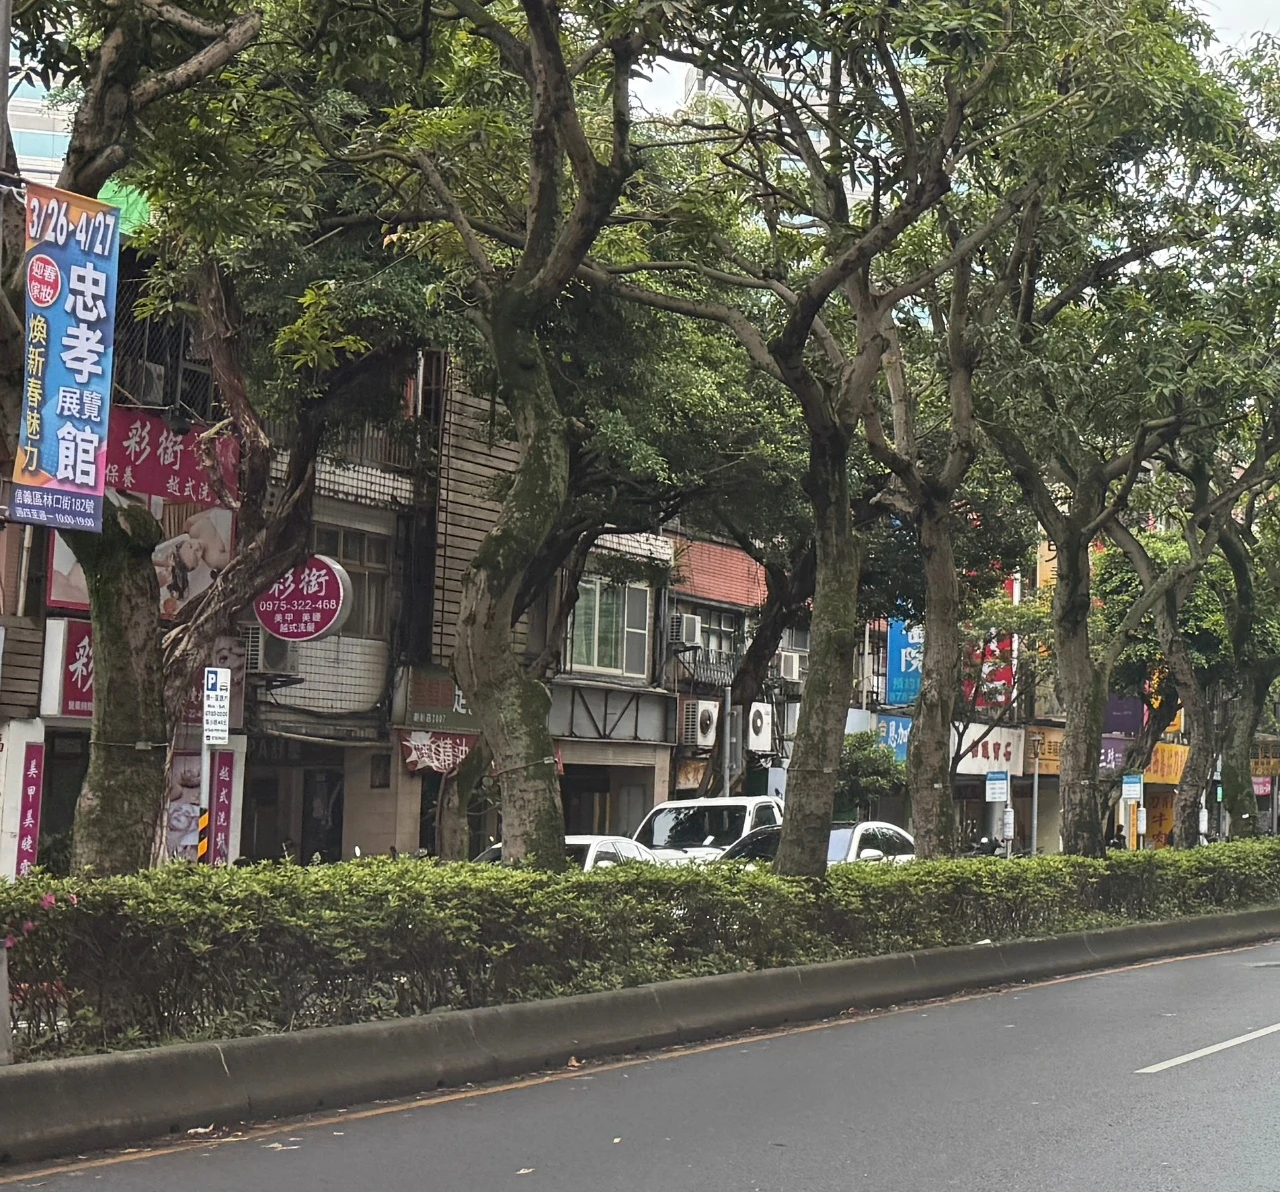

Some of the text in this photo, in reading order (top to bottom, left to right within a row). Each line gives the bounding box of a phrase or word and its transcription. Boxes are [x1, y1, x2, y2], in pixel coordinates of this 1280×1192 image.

[29, 197, 116, 256] 3/26 4/27
[22, 313, 47, 472] 煥新春魅力
[260, 600, 336, 610] 0975-322-468
